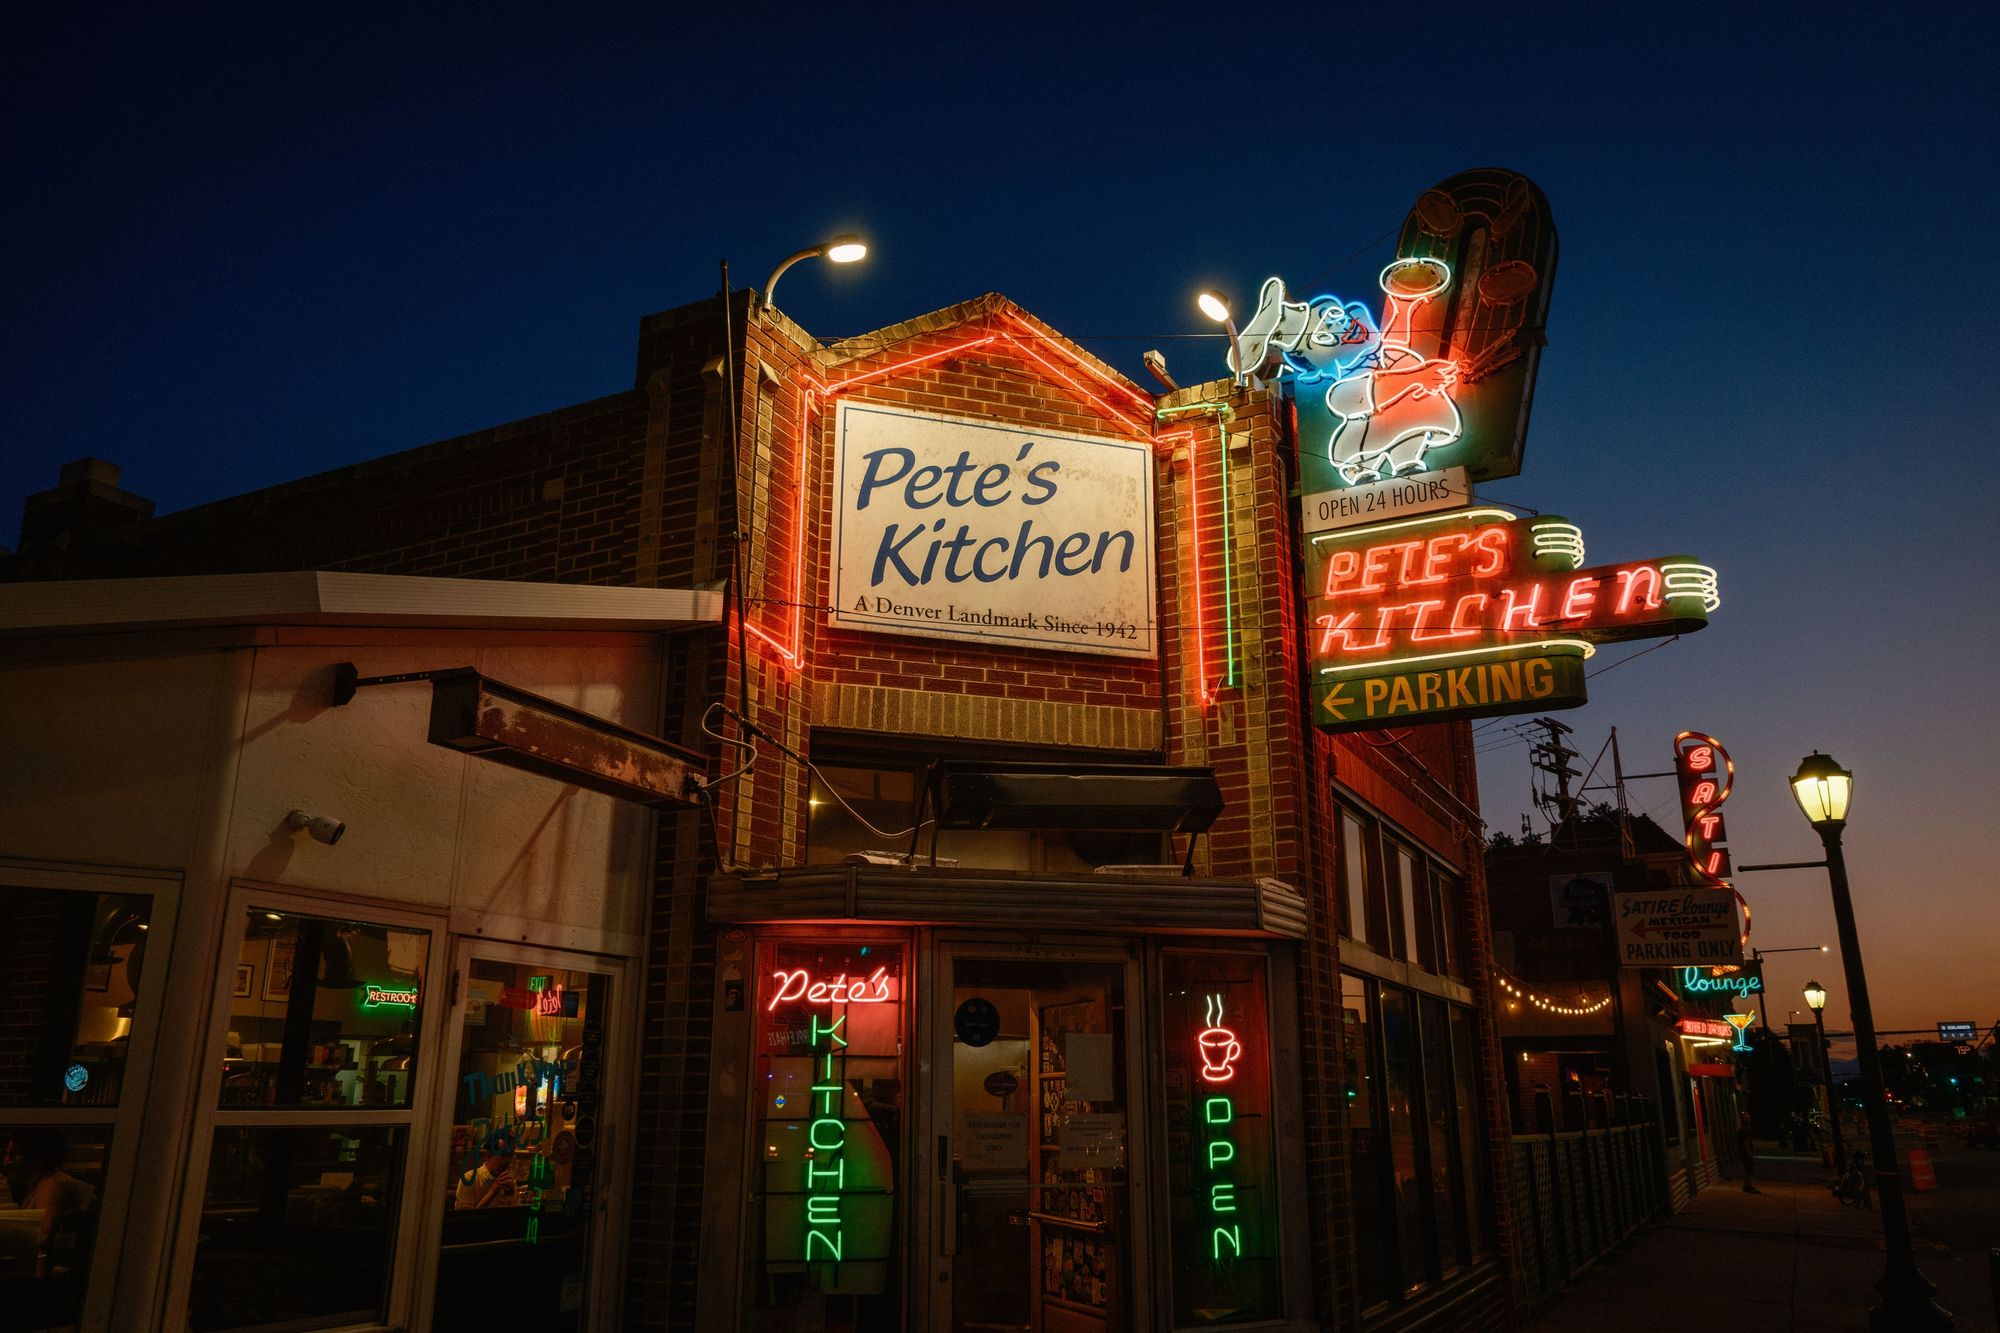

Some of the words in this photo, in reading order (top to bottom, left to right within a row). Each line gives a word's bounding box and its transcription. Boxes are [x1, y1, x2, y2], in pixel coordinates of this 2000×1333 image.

[856, 442, 1061, 511] Pete's
[1319, 496, 1360, 520] OPEN
[1366, 491, 1386, 512] 24
[1393, 479, 1450, 507] HOURS
[871, 518, 1135, 587] Kitchen
[1324, 525, 1508, 600] PETE'S
[854, 595, 868, 612] A
[876, 597, 942, 619] Denver
[948, 605, 1038, 630] Landmark
[1044, 615, 1089, 634] Since
[1096, 621, 1137, 640] 1942
[1316, 565, 1664, 654] KITCHEN
[1365, 658, 1554, 716] PARKING
[1689, 746, 1721, 874] SATI
[1622, 899, 1679, 917] SATIRE
[1674, 894, 1730, 918] lounge
[1648, 915, 1711, 927] MEXICAN
[1627, 942, 1691, 960] PARKING
[1699, 940, 1735, 957] ONLY
[1663, 931, 1701, 939] FOOD
[768, 967, 890, 1011] Pete's
[1684, 966, 1760, 998] lounge
[464, 1062, 530, 1104] Thank
[806, 1014, 848, 1261] KITCHEN
[1206, 1098, 1240, 1259] OPEN
